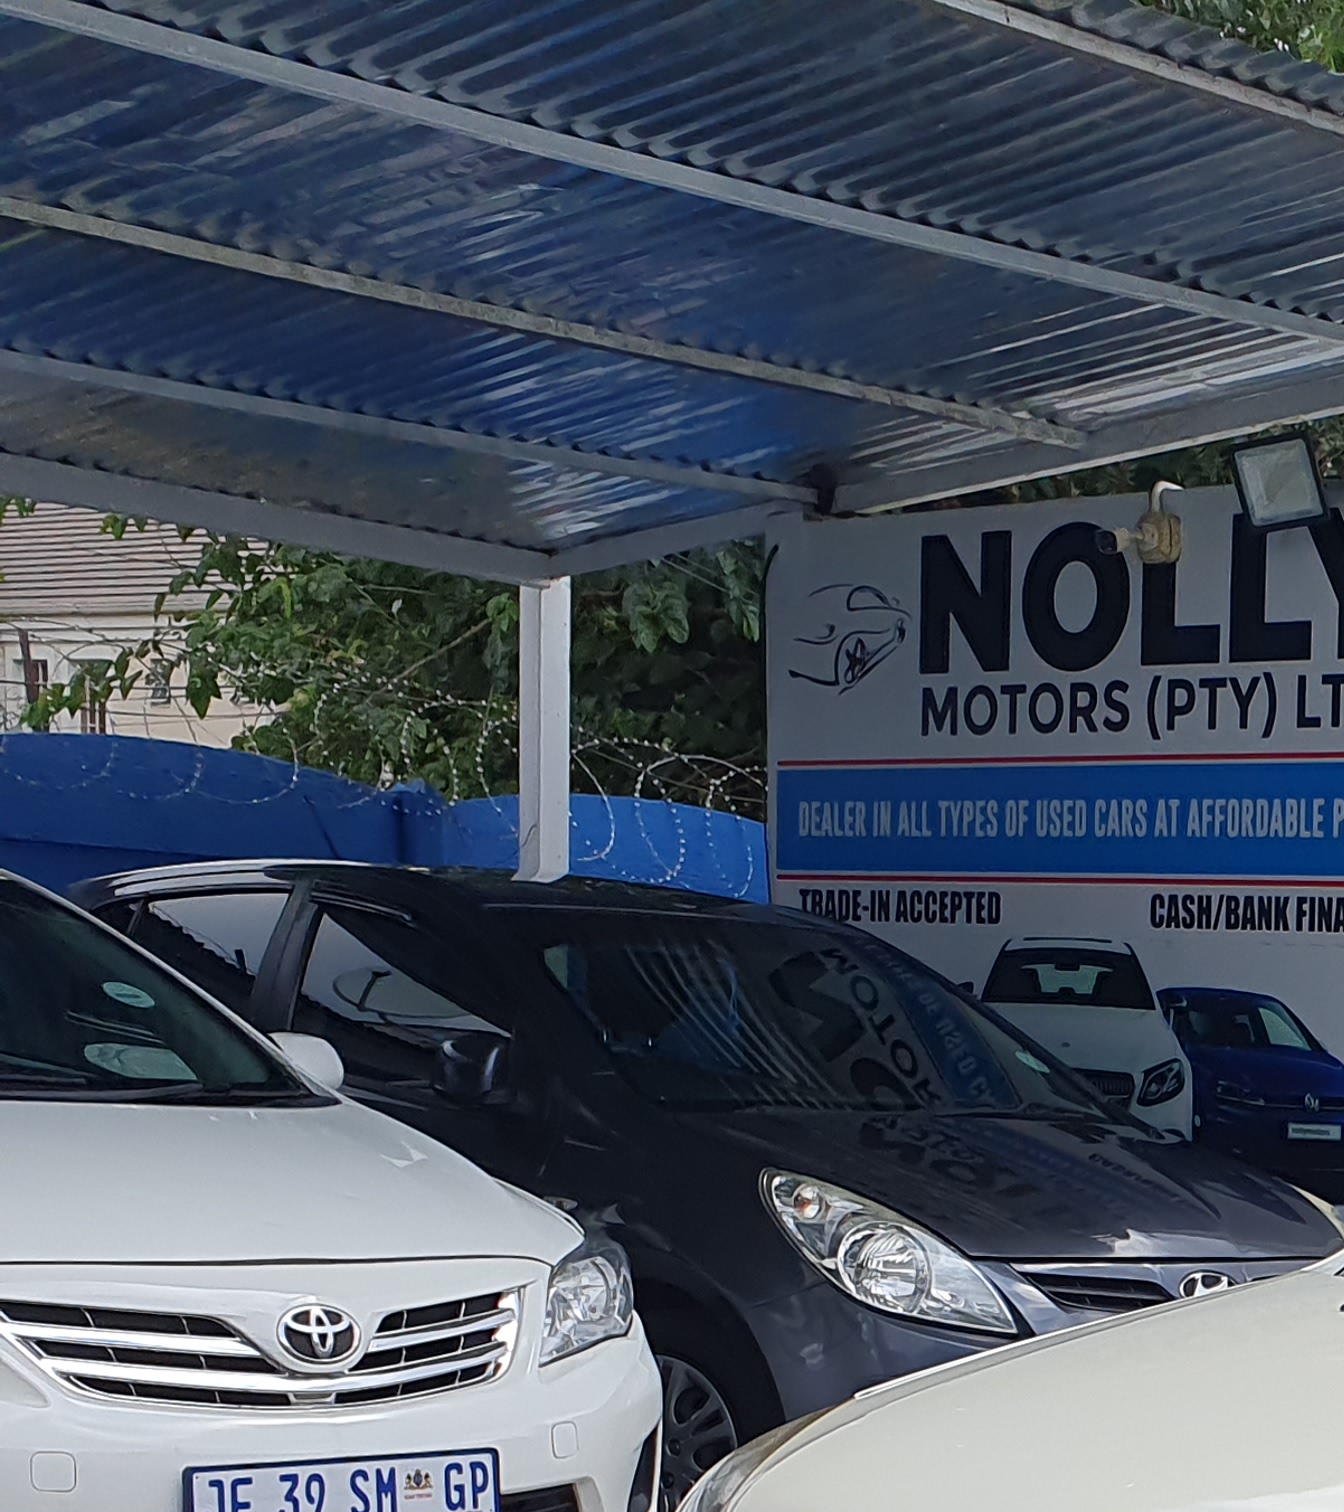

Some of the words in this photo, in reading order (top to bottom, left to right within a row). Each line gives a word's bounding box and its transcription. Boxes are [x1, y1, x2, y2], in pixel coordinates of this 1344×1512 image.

[921, 680, 1130, 736] MOTORS
[1147, 672, 1277, 740] (PTY)
[799, 799, 866, 838] DEALER
[873, 799, 892, 838] IN
[897, 799, 932, 838] ALL
[938, 799, 998, 838] TYPES
[1005, 799, 1029, 838] OF
[1036, 799, 1087, 838] USED
[1094, 799, 1147, 838] CARS
[1154, 799, 1180, 838] AT
[1187, 799, 1325, 838] AFFORDABLE
[799, 889, 891, 923] TRADE-IN
[895, 890, 1001, 924] ACCEPTED
[1150, 894, 1290, 931] CASH/BANK
[444, 1461, 490, 1511] GP
